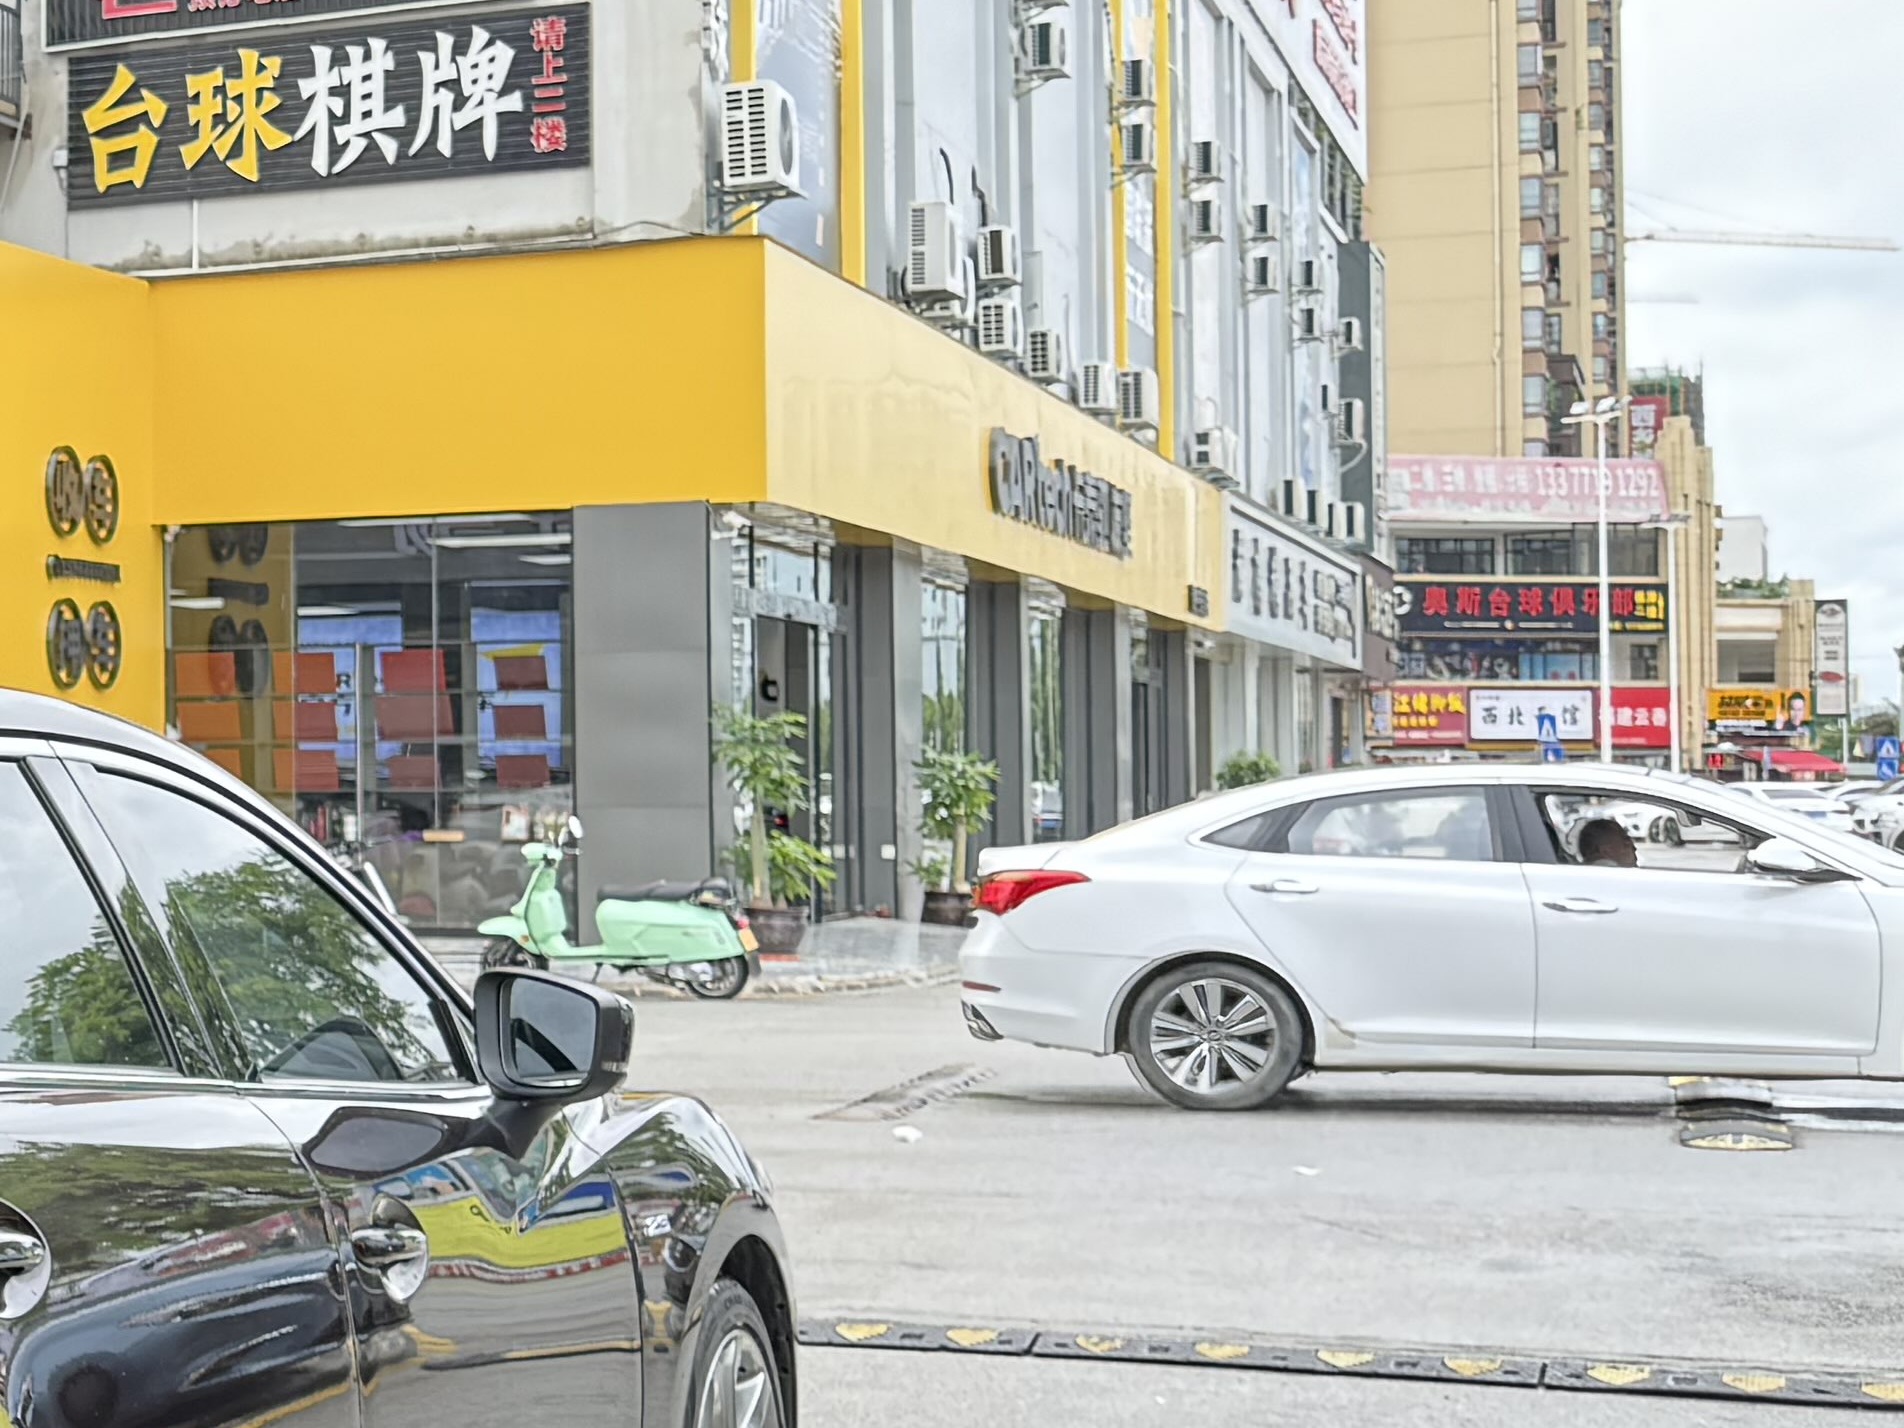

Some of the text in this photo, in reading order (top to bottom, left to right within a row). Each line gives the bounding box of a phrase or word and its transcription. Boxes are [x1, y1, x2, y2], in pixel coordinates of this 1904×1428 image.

[80, 25, 525, 194] 台球棋牌
[530, 15, 569, 155] 请上二楼
[1481, 705, 1581, 727] 西北馆
